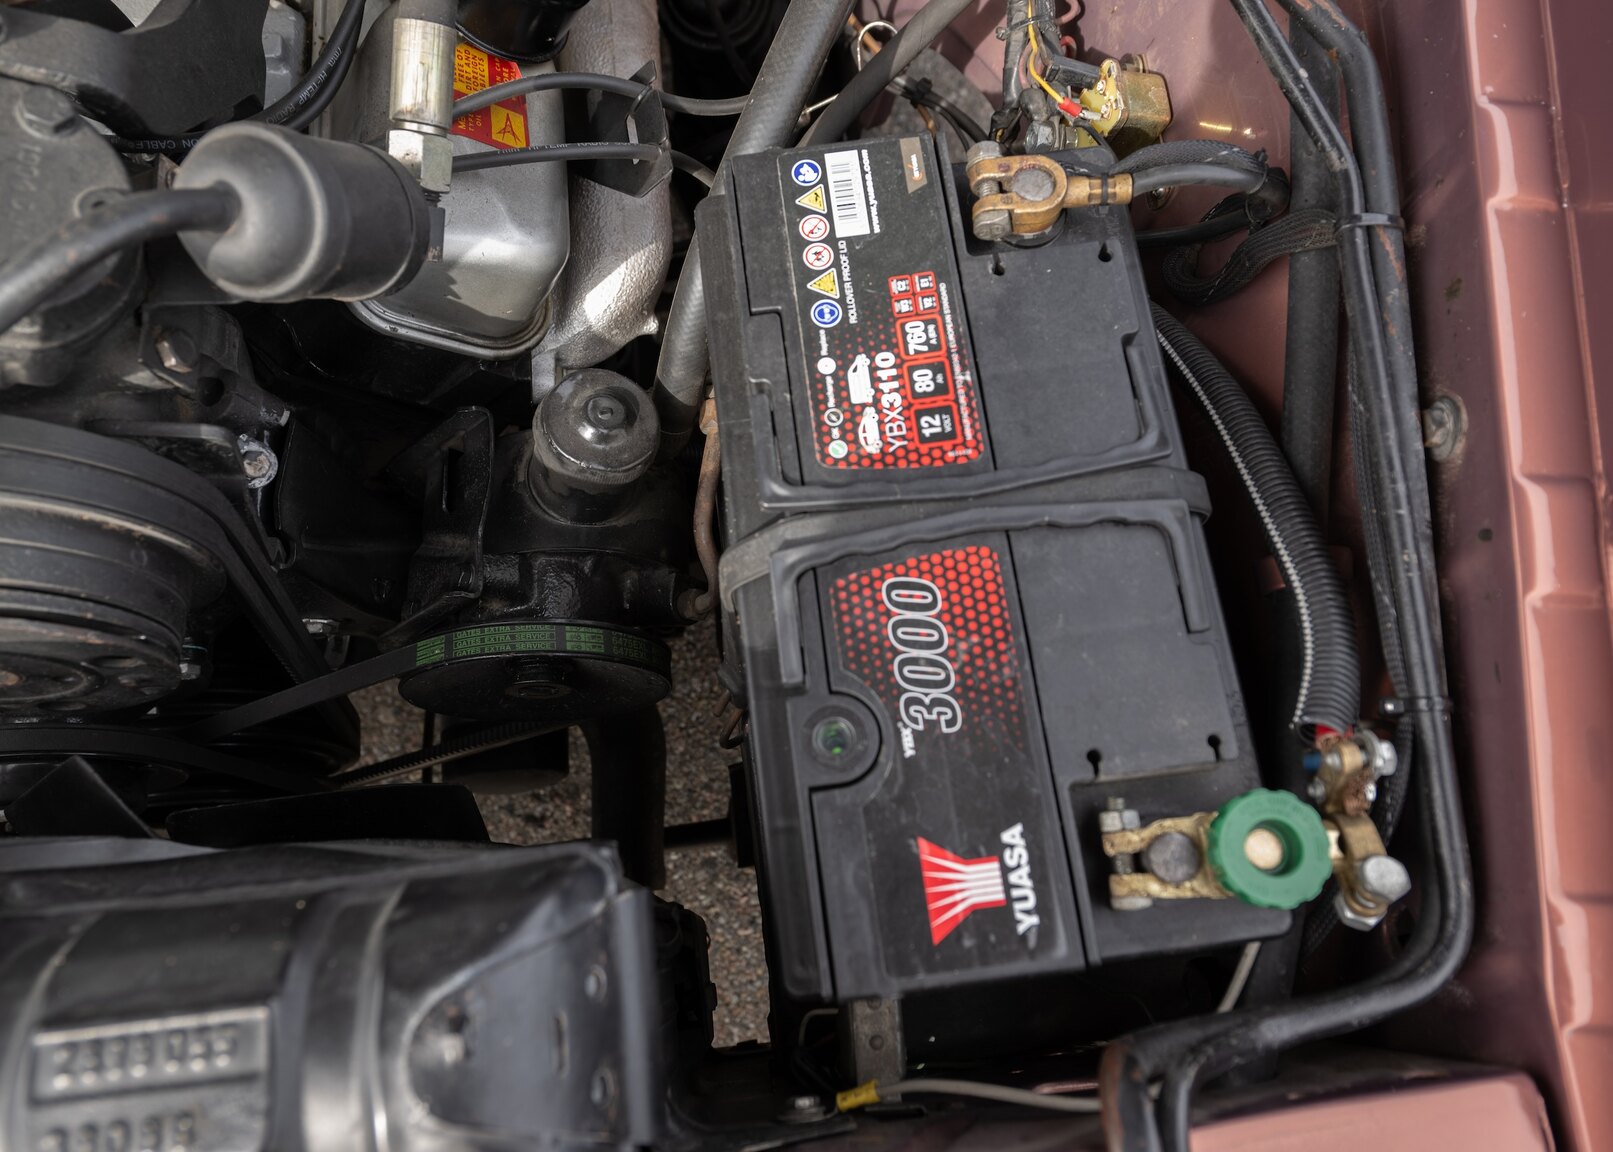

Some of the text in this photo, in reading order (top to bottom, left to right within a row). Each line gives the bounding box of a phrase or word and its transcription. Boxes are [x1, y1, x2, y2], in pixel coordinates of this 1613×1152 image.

[457, 49, 465, 84] FREE OF
[298, 70, 328, 105] HI-TEMP
[135, 138, 200, 150] ON CABLE
[861, 149, 880, 234] www.yuasa.com
[838, 240, 858, 324] ROLLOVER PROOF LID
[939, 282, 951, 315] STANDARD
[905, 320, 929, 355] 760
[944, 315, 957, 347] EUROPEAN
[825, 375, 836, 408] Recharge
[912, 369, 935, 393] 80
[935, 373, 944, 384] Ah
[875, 351, 908, 453] YBX3110
[831, 427, 840, 440] OK
[920, 413, 943, 438] 12
[942, 413, 953, 434] VOLT
[456, 628, 481, 638] GATES
[484, 626, 511, 634] EXTRA
[456, 632, 552, 648] GATES EXTRA SERVICE
[456, 641, 552, 657] GATES EXTRA SERVICE
[881, 576, 962, 734] 3000
[1000, 822, 1040, 935] YUASA
